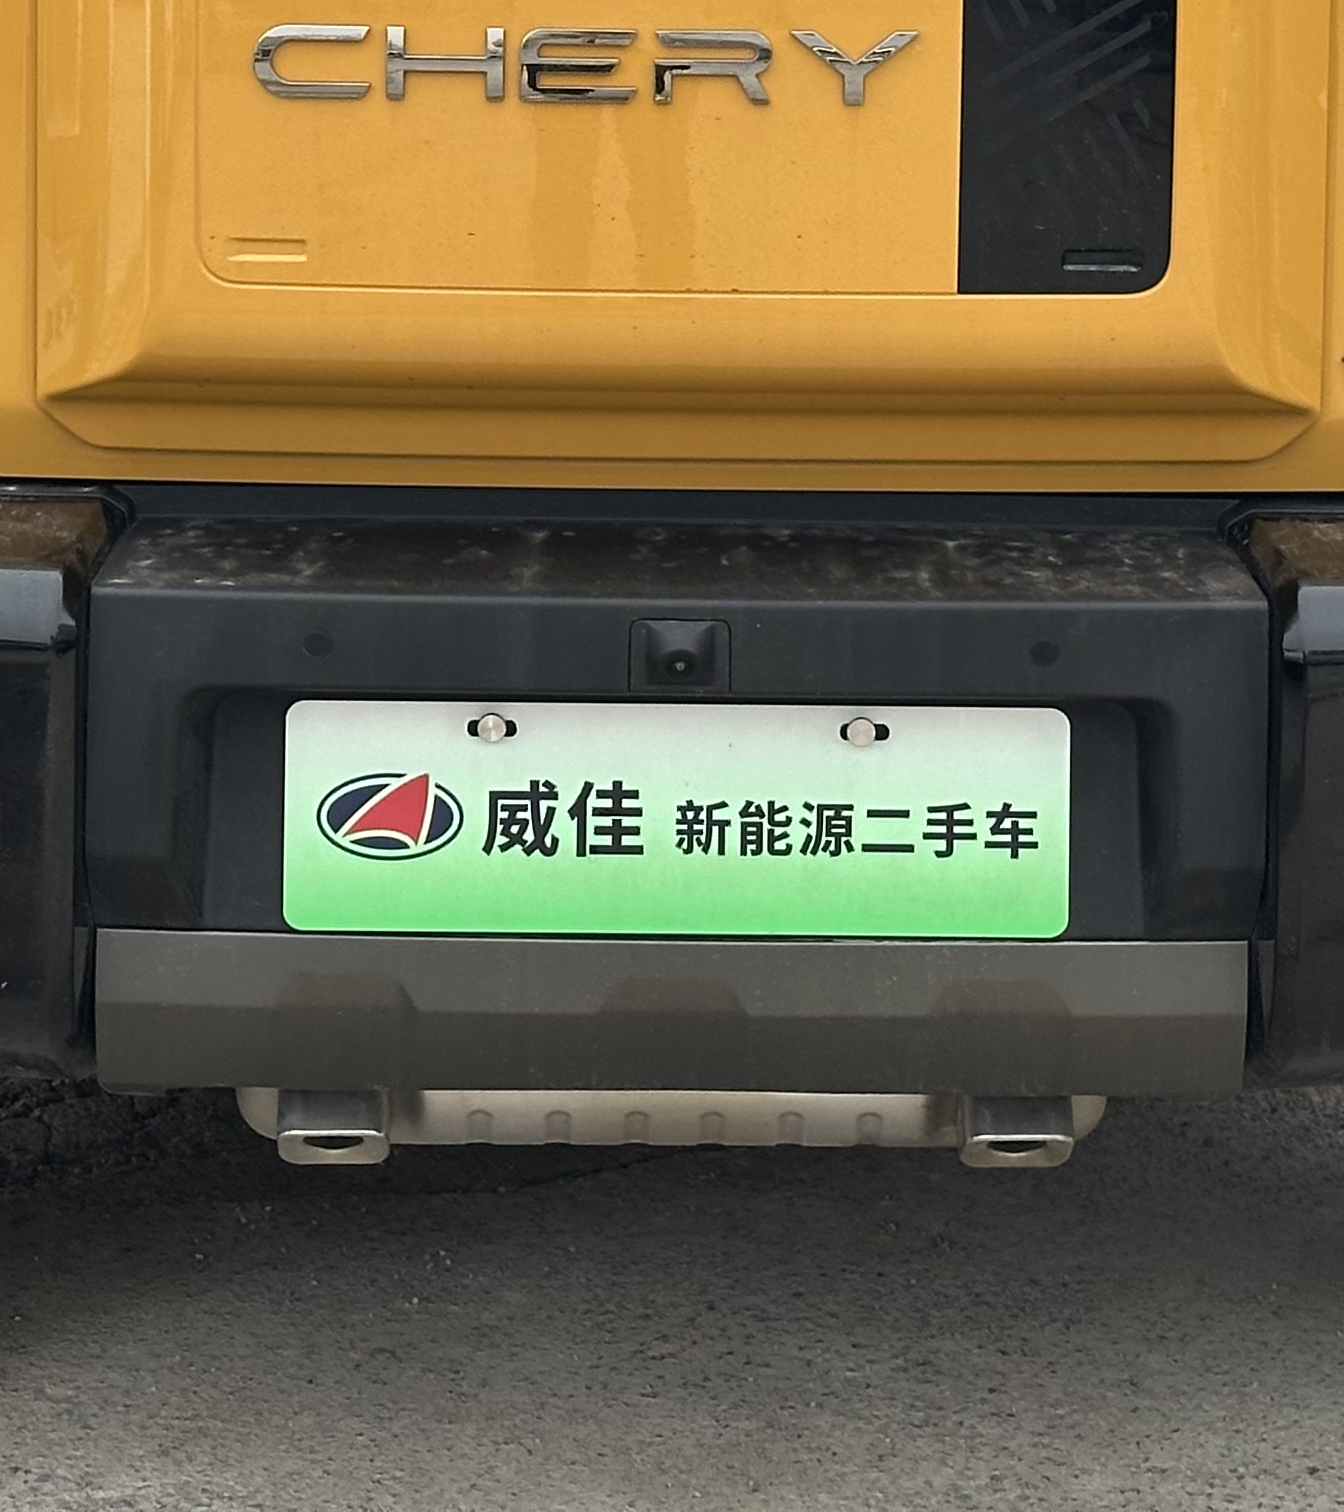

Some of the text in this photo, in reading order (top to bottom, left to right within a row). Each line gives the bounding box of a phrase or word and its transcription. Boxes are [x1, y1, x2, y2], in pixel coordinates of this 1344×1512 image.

[252, 21, 920, 107] CHERY
[480, 779, 1041, 861] 威佳 新能源二手车
